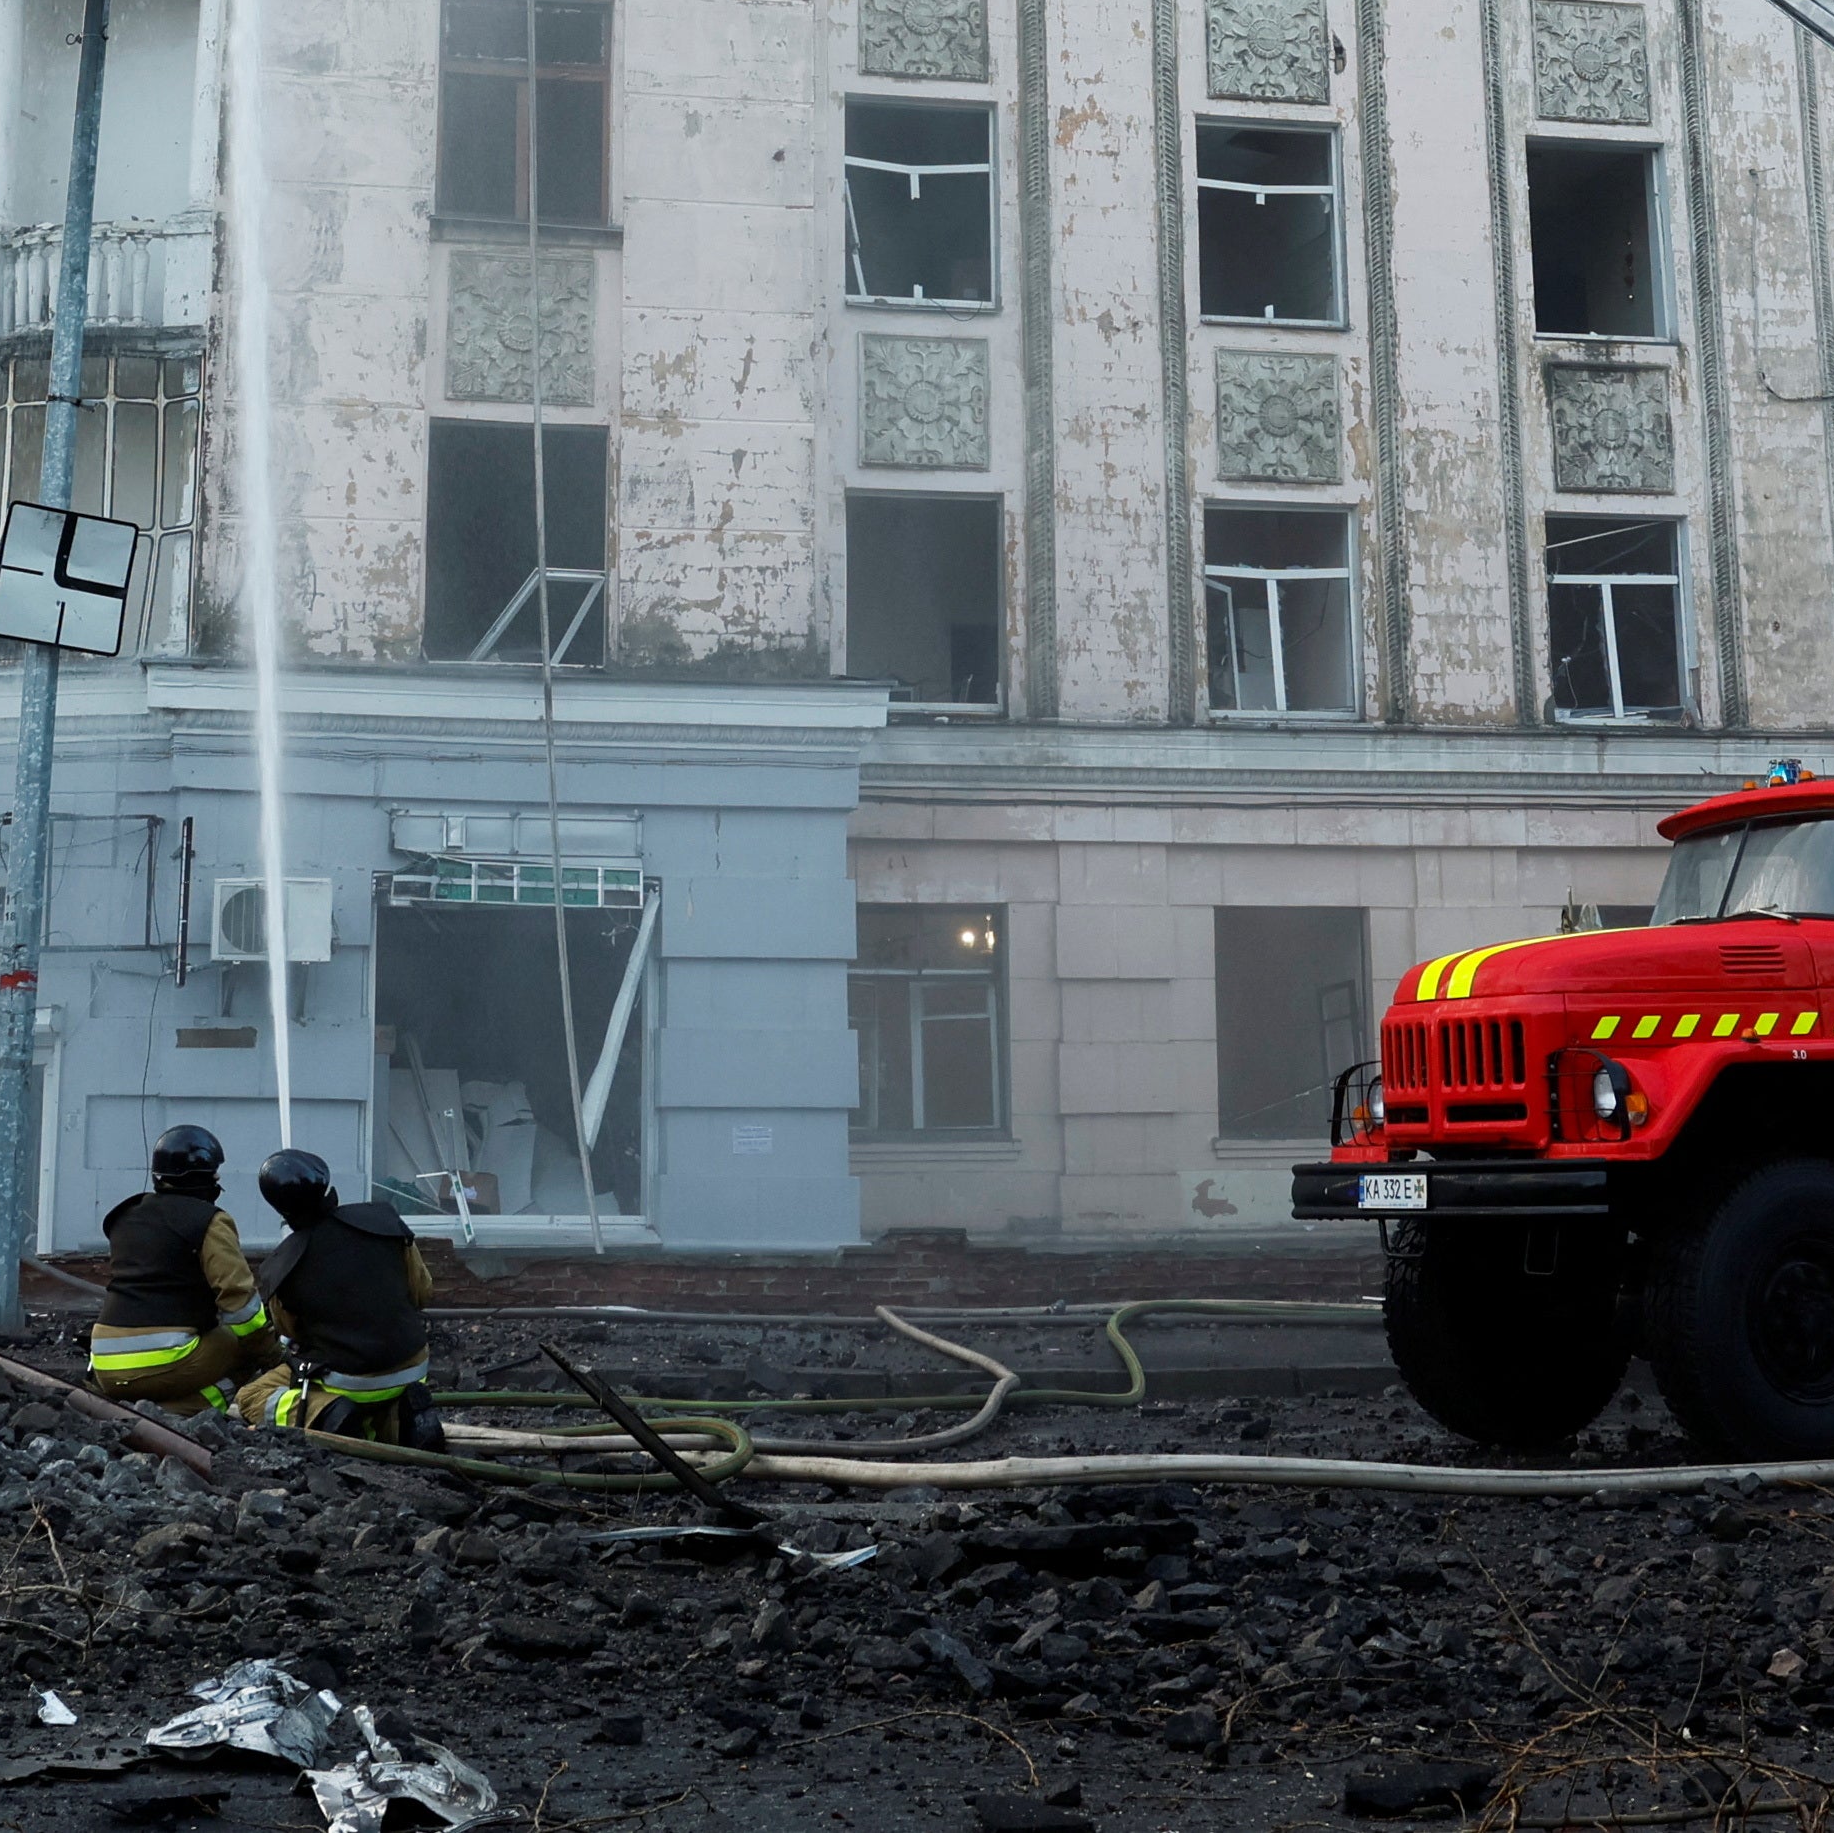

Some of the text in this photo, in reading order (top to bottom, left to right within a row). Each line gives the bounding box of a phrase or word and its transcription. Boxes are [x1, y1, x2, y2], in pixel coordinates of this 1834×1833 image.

[1365, 1178, 1412, 1199] KA 332 E
